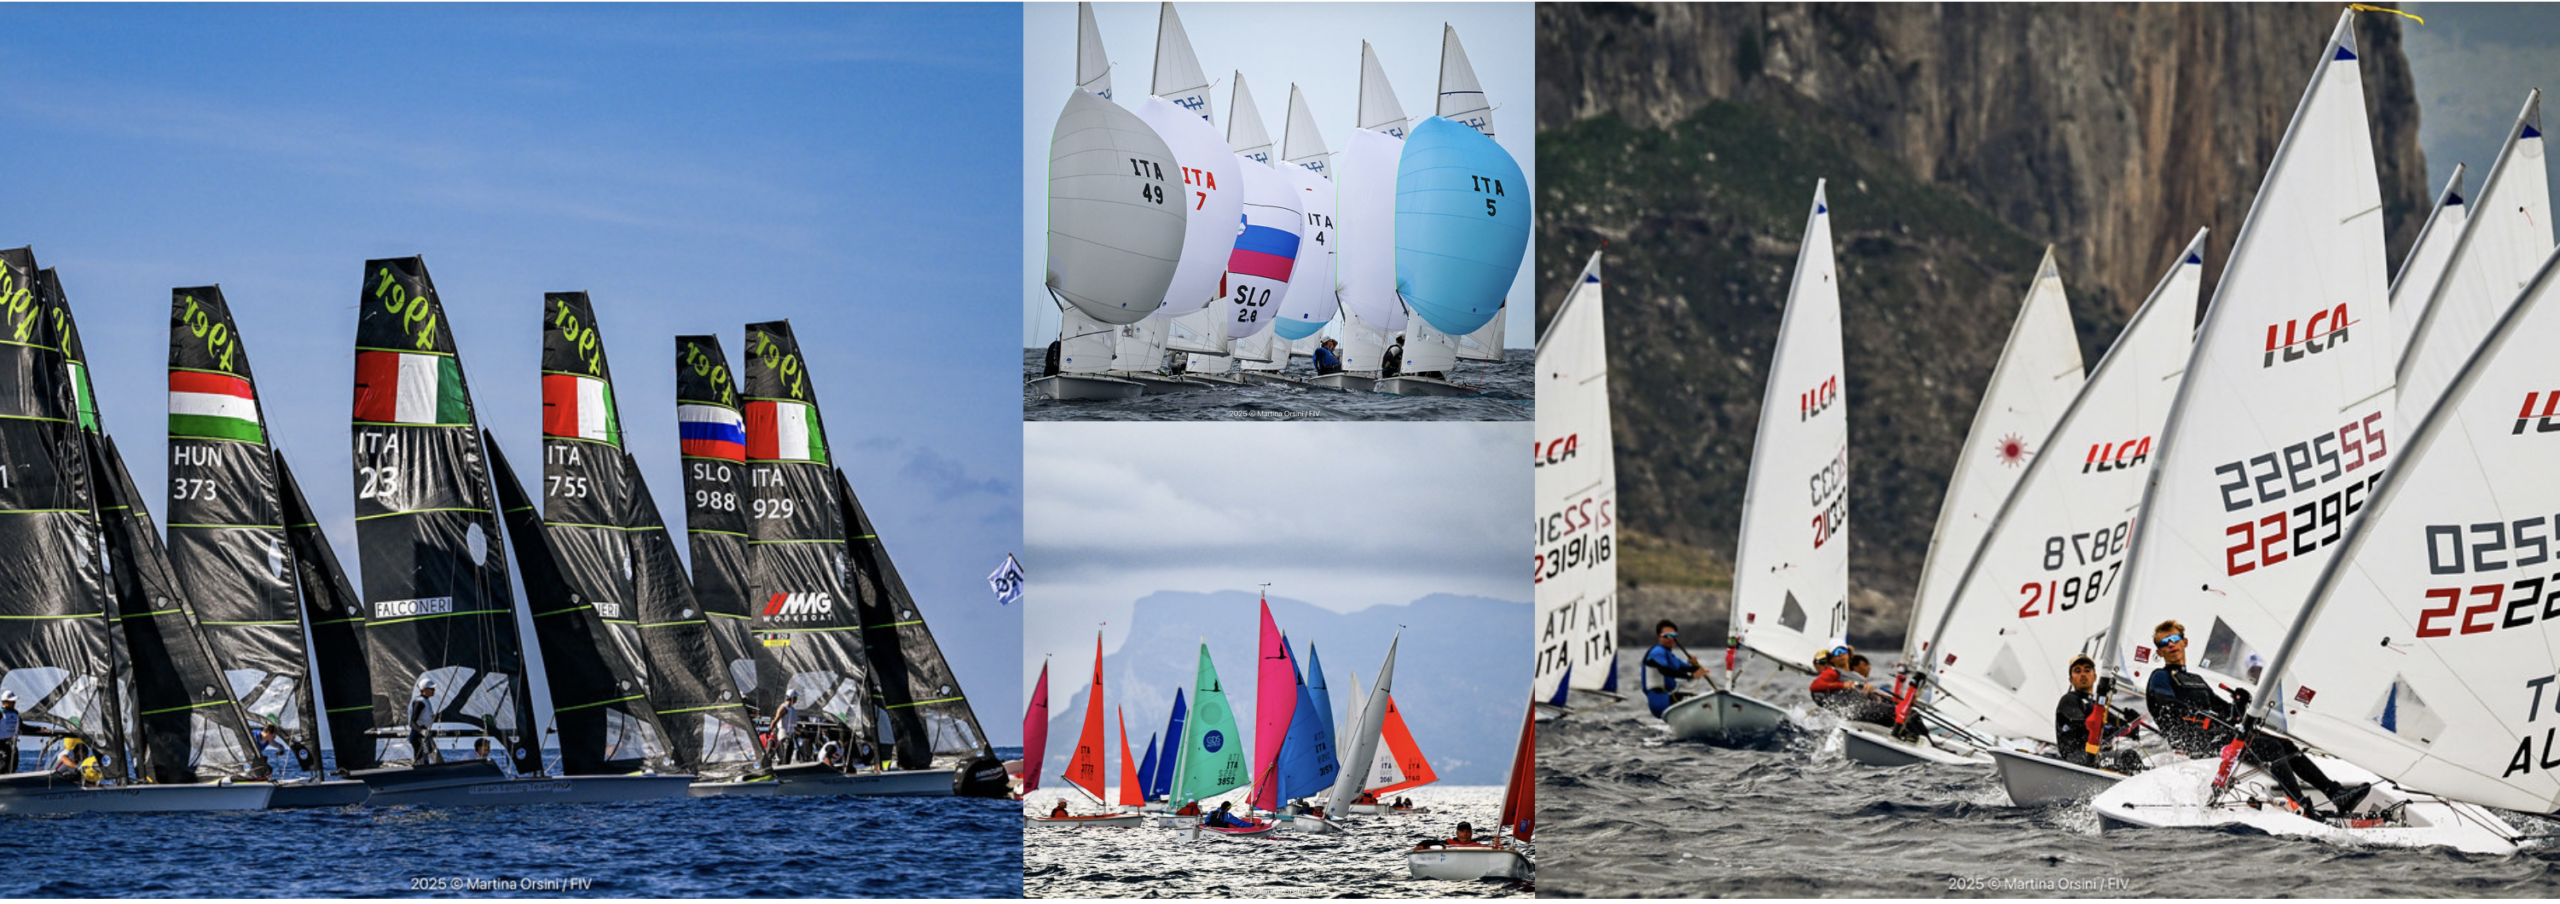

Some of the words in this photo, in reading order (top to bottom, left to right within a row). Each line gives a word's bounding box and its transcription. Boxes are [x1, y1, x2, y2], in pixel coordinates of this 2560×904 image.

[1130, 158, 1164, 181] ITA
[1182, 166, 1216, 190] ITA
[1142, 183, 1163, 205] 49
[1471, 175, 1505, 197] ITA
[1196, 191, 1207, 211] 7
[1486, 198, 1497, 217] 5
[1308, 212, 1333, 229] ITA
[1315, 231, 1325, 246] 4
[1234, 284, 1271, 307] SLO
[2263, 302, 2351, 368] ILCA
[1801, 374, 1837, 422] ILCA
[358, 432, 399, 454] ITA
[174, 446, 223, 467] HUN
[548, 445, 581, 466] ITA
[2082, 435, 2152, 474] ILCA
[359, 466, 398, 499] 23
[693, 463, 731, 483] SLO
[752, 468, 784, 488] ITA
[173, 478, 217, 500] 373
[549, 475, 587, 498] 755
[695, 490, 736, 512] 988
[752, 498, 794, 519] 929
[2019, 560, 2123, 619] 21987
[376, 598, 451, 617] FALCONERI
[779, 592, 832, 615] MAG
[762, 614, 832, 622] WORKBOAT
[1585, 630, 1612, 666] ITA
[1535, 640, 1567, 679] ITA
[1080, 746, 1090, 754] ITA
[1315, 742, 1326, 753] ITA
[1227, 762, 1238, 770] ITA
[1319, 763, 1333, 776] 3159
[1217, 777, 1235, 786] 3852
